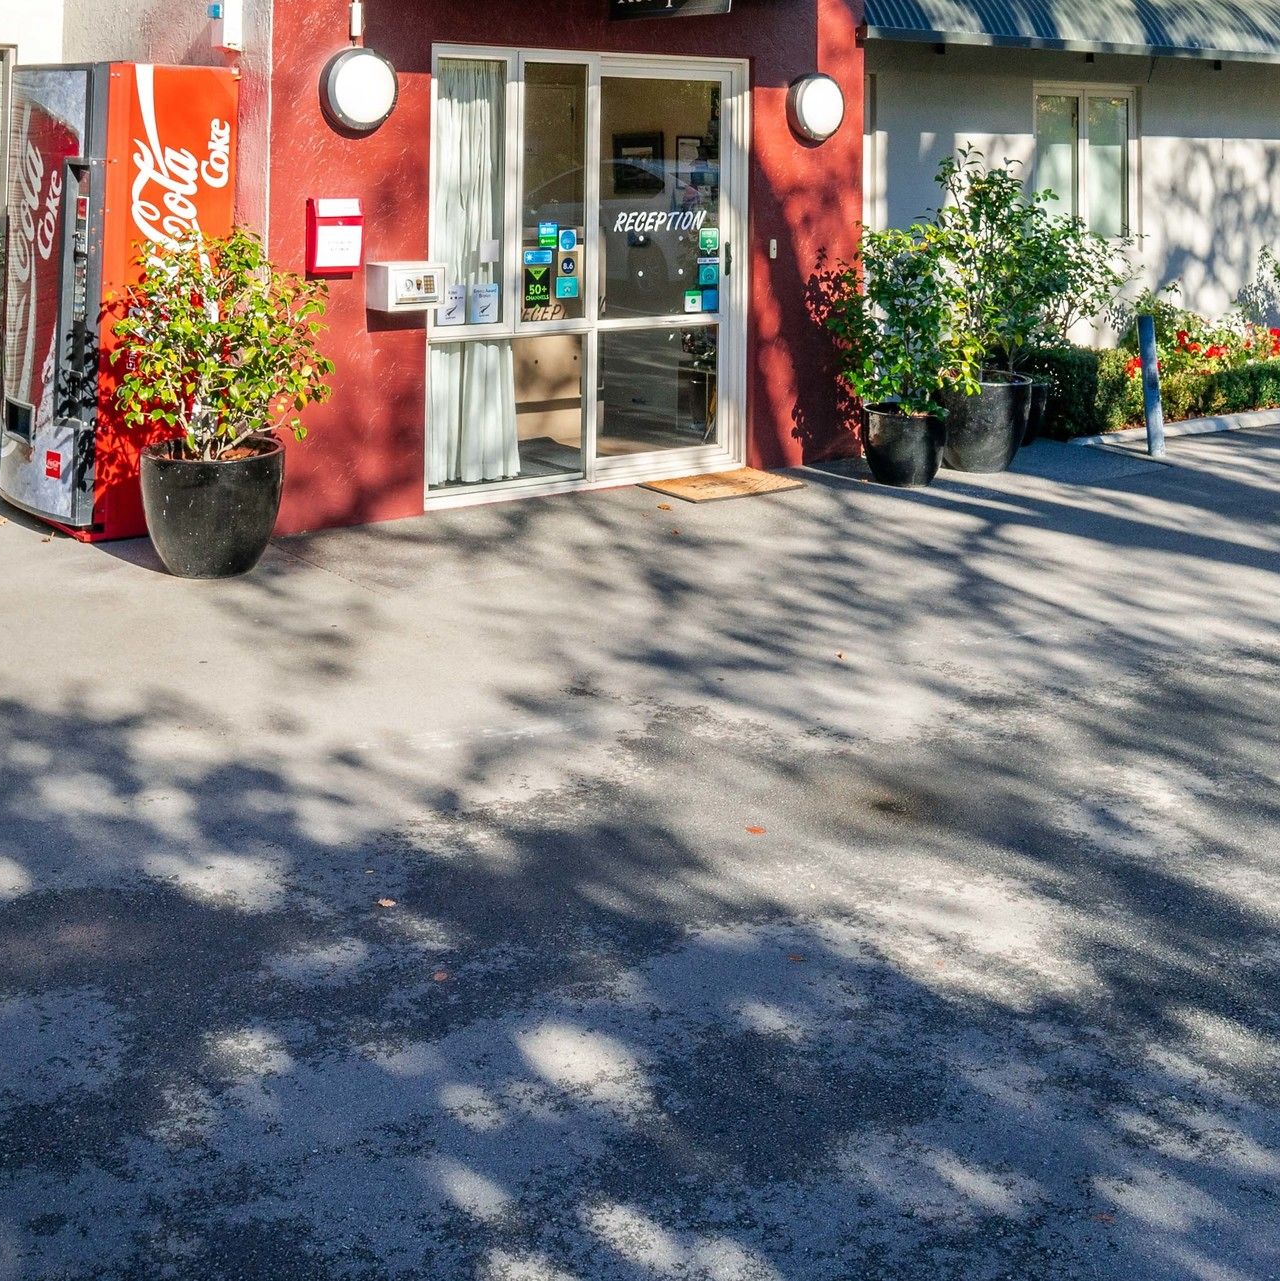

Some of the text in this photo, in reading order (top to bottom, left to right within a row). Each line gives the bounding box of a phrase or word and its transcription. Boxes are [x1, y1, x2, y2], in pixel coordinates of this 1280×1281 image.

[201, 118, 231, 188] Coke
[37, 170, 62, 260] Coke
[613, 209, 707, 232] RECEPTION
[563, 262, 574, 270] 8.6
[529, 284, 548, 295] 50+
